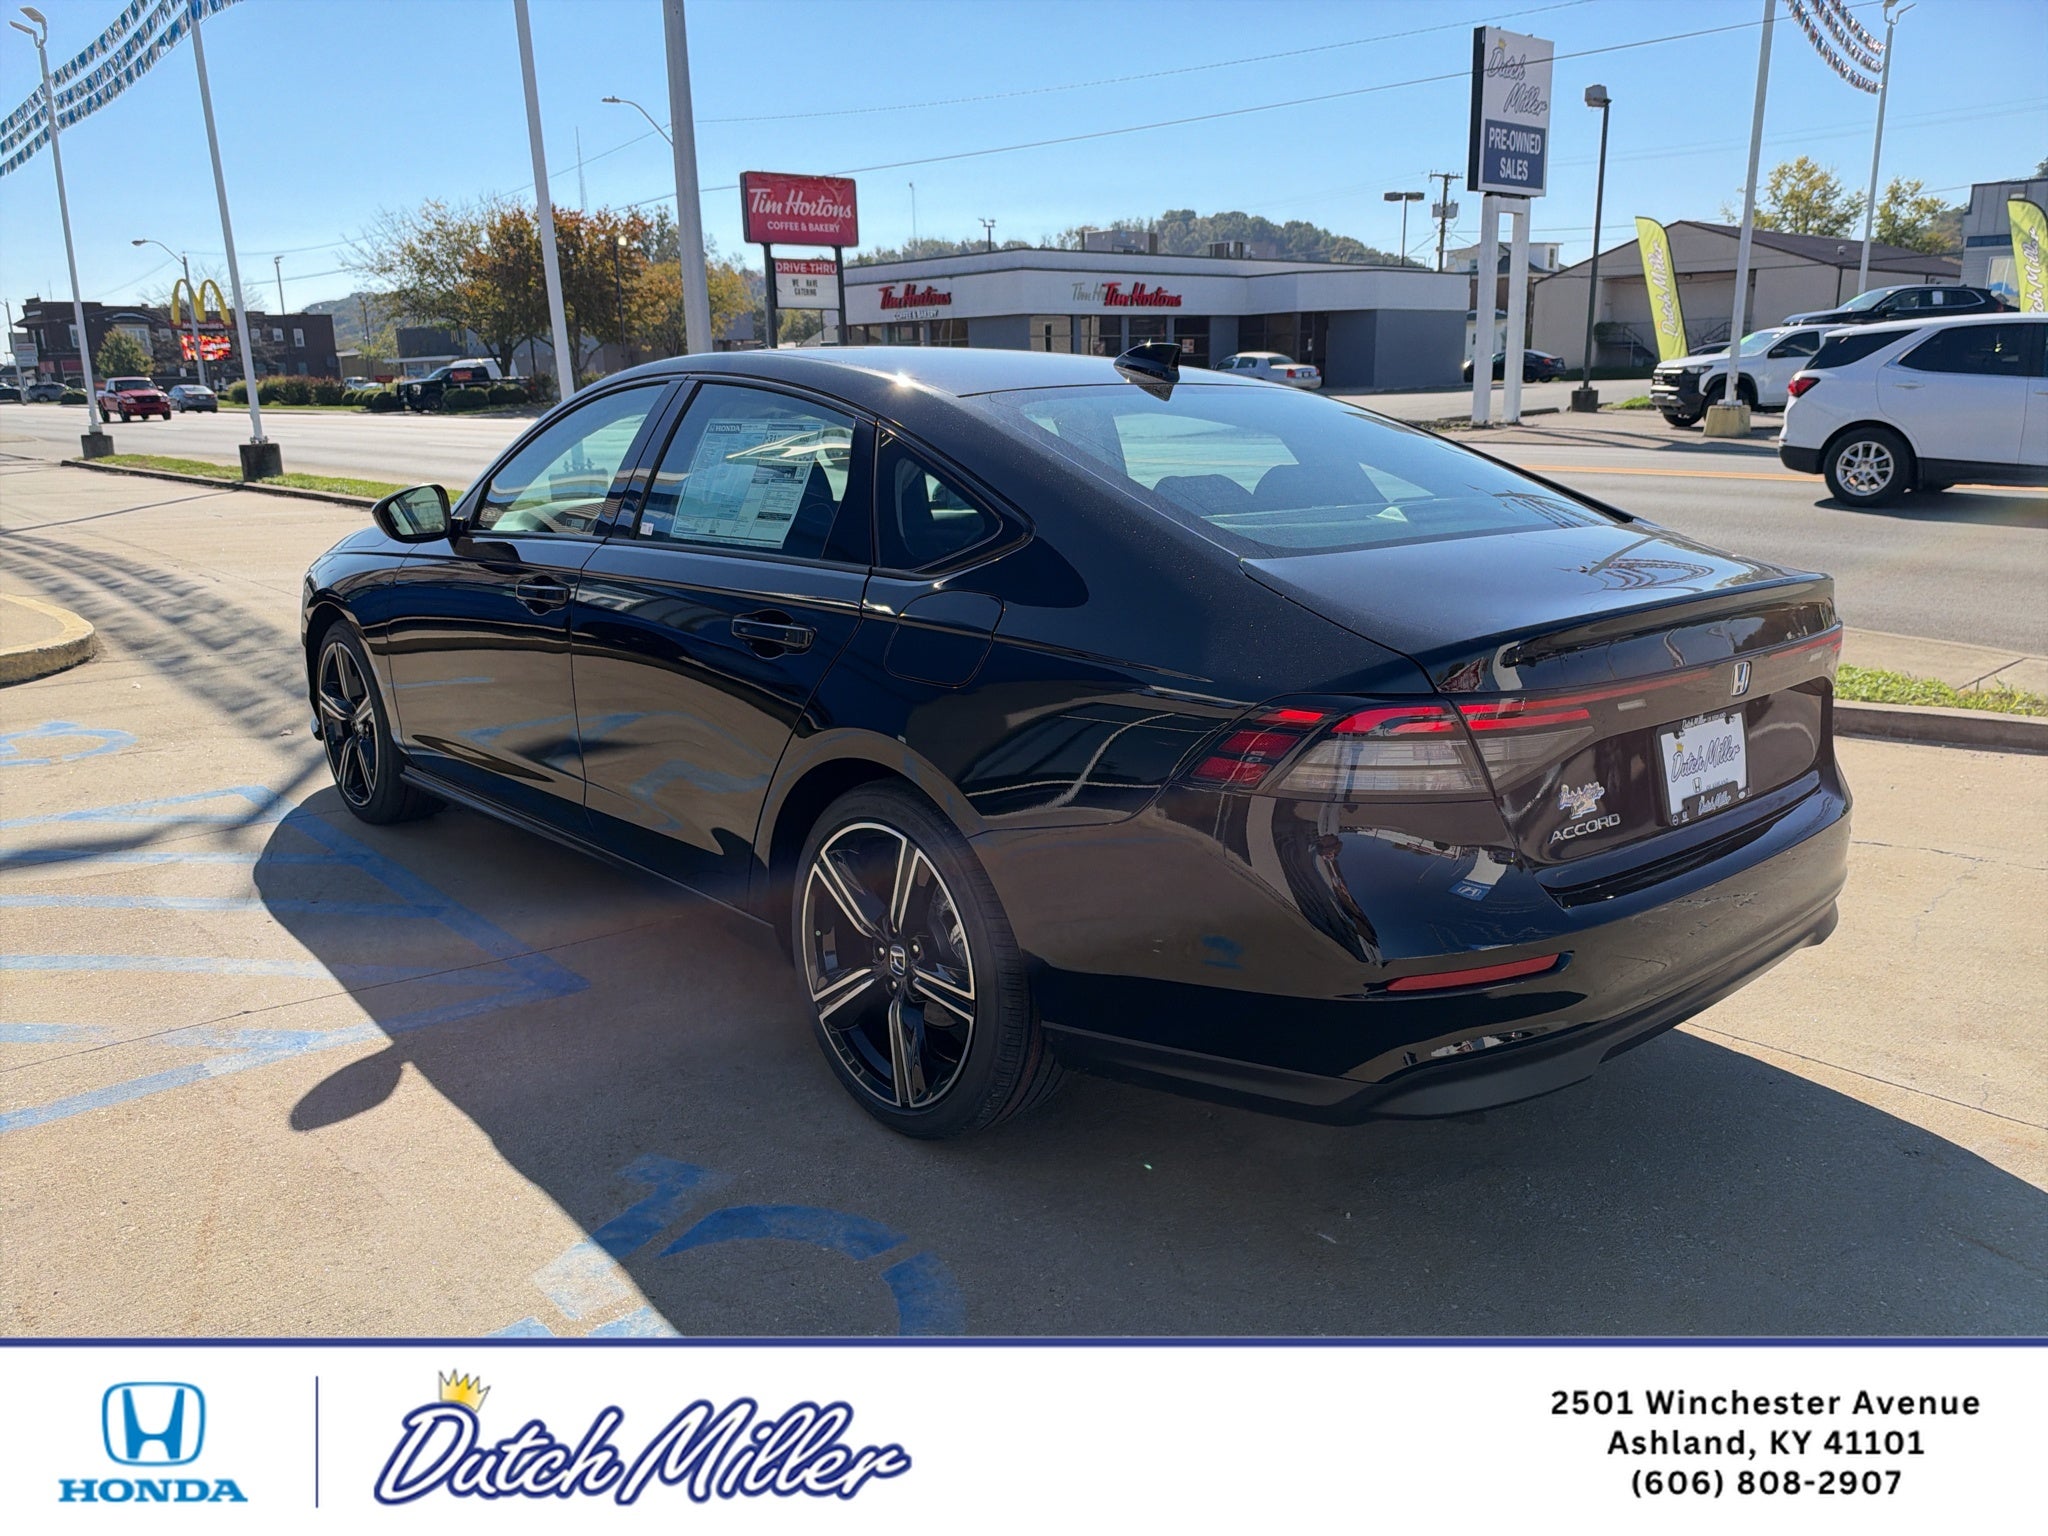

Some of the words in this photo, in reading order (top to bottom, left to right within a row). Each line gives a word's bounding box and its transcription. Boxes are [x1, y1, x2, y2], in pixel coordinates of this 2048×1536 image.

[1487, 47, 1526, 81] Dutch
[1503, 82, 1548, 116] Miller
[1488, 127, 1542, 154] PRE-OWNED
[1499, 157, 1529, 181] SALES
[749, 188, 782, 215] Tim
[785, 188, 852, 218] Hortons
[767, 221, 799, 232] COFFEE
[808, 223, 840, 233] BAKERY
[775, 262, 807, 273] DRIVE
[809, 263, 837, 273] THRU
[1102, 282, 1129, 306] Tim
[1130, 282, 1182, 307] Hortons
[715, 424, 741, 433] HONDA
[1671, 745, 1704, 782] Dutch
[1704, 735, 1740, 772] Miller
[1550, 813, 1621, 844] ACCORD
